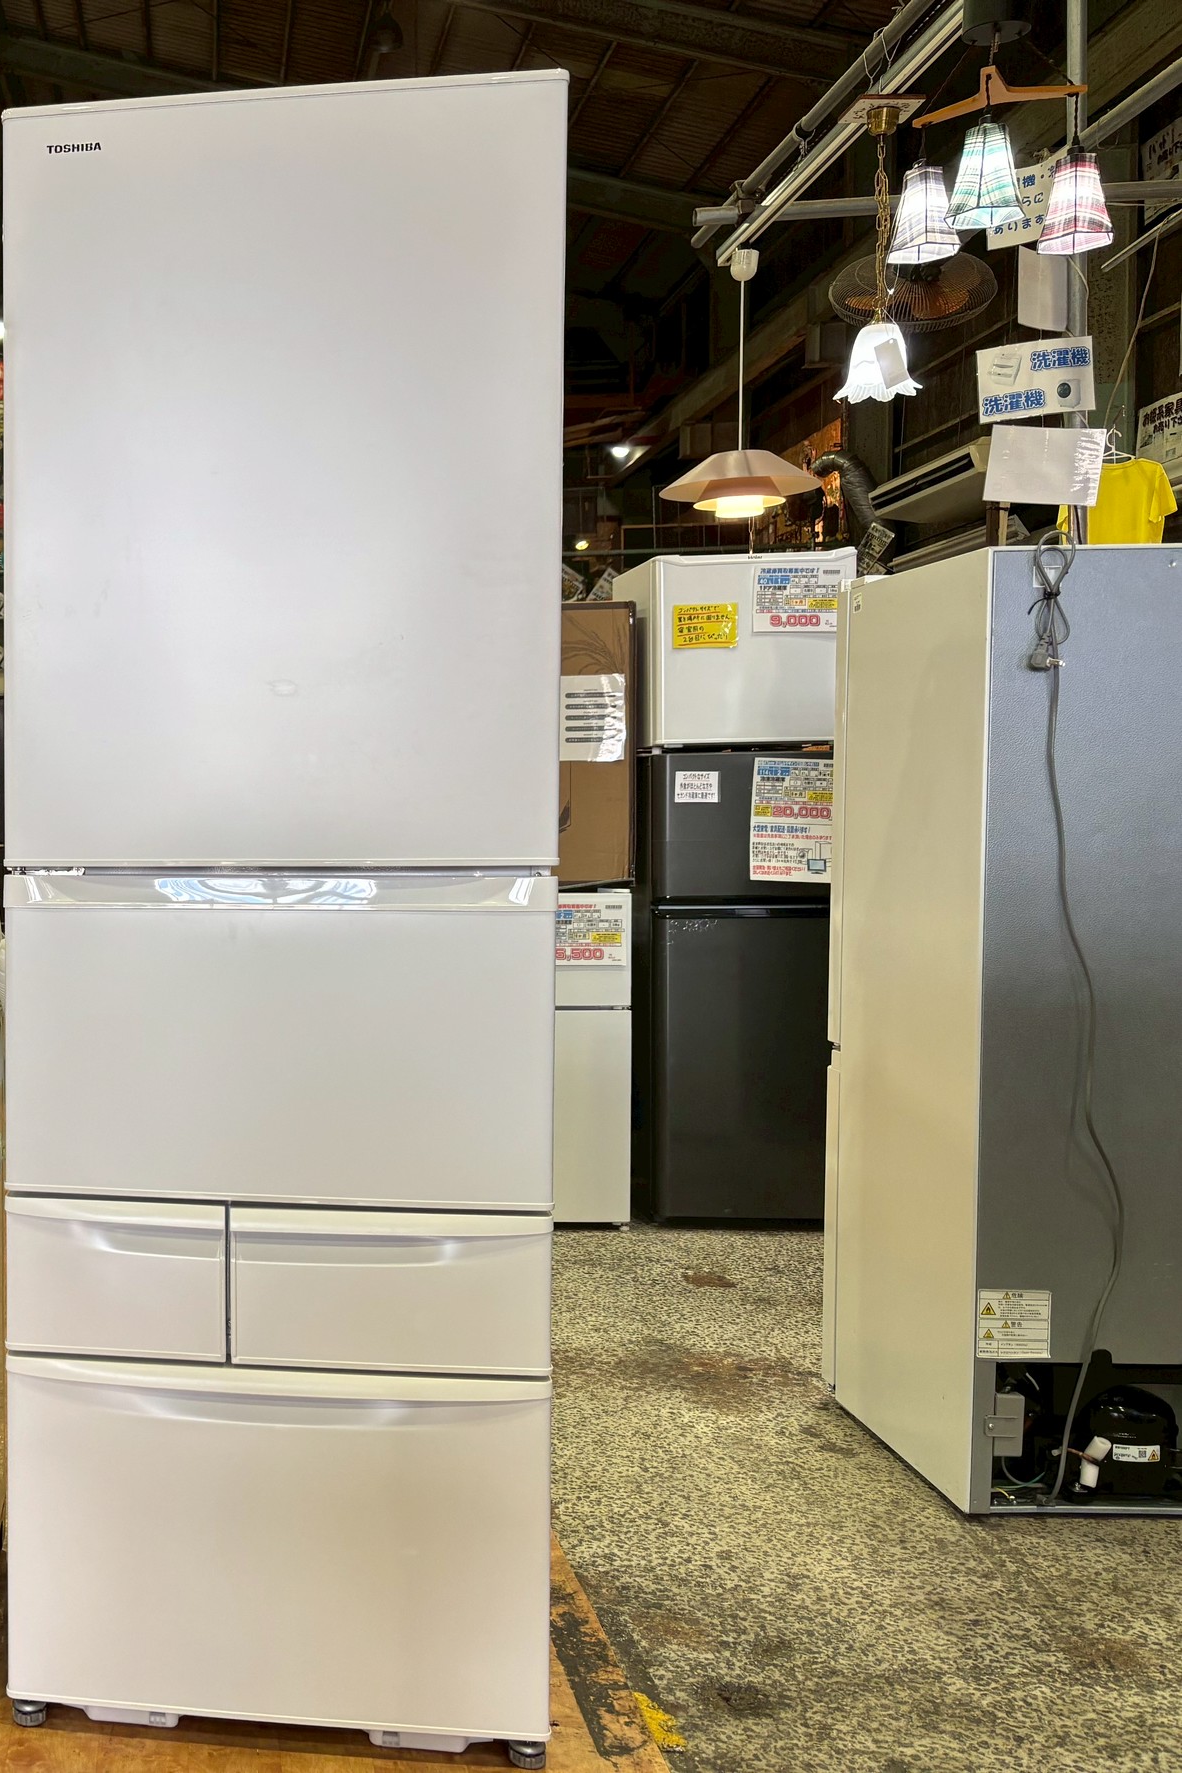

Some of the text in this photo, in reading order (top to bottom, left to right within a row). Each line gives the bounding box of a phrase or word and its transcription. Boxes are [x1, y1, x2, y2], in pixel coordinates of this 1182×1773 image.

[47, 143, 101, 154] TOSHIBA
[1030, 346, 1091, 371] 洗濯機
[983, 388, 1046, 416] 洗濯機
[770, 614, 820, 628] 9,000
[772, 806, 831, 819] 20,000
